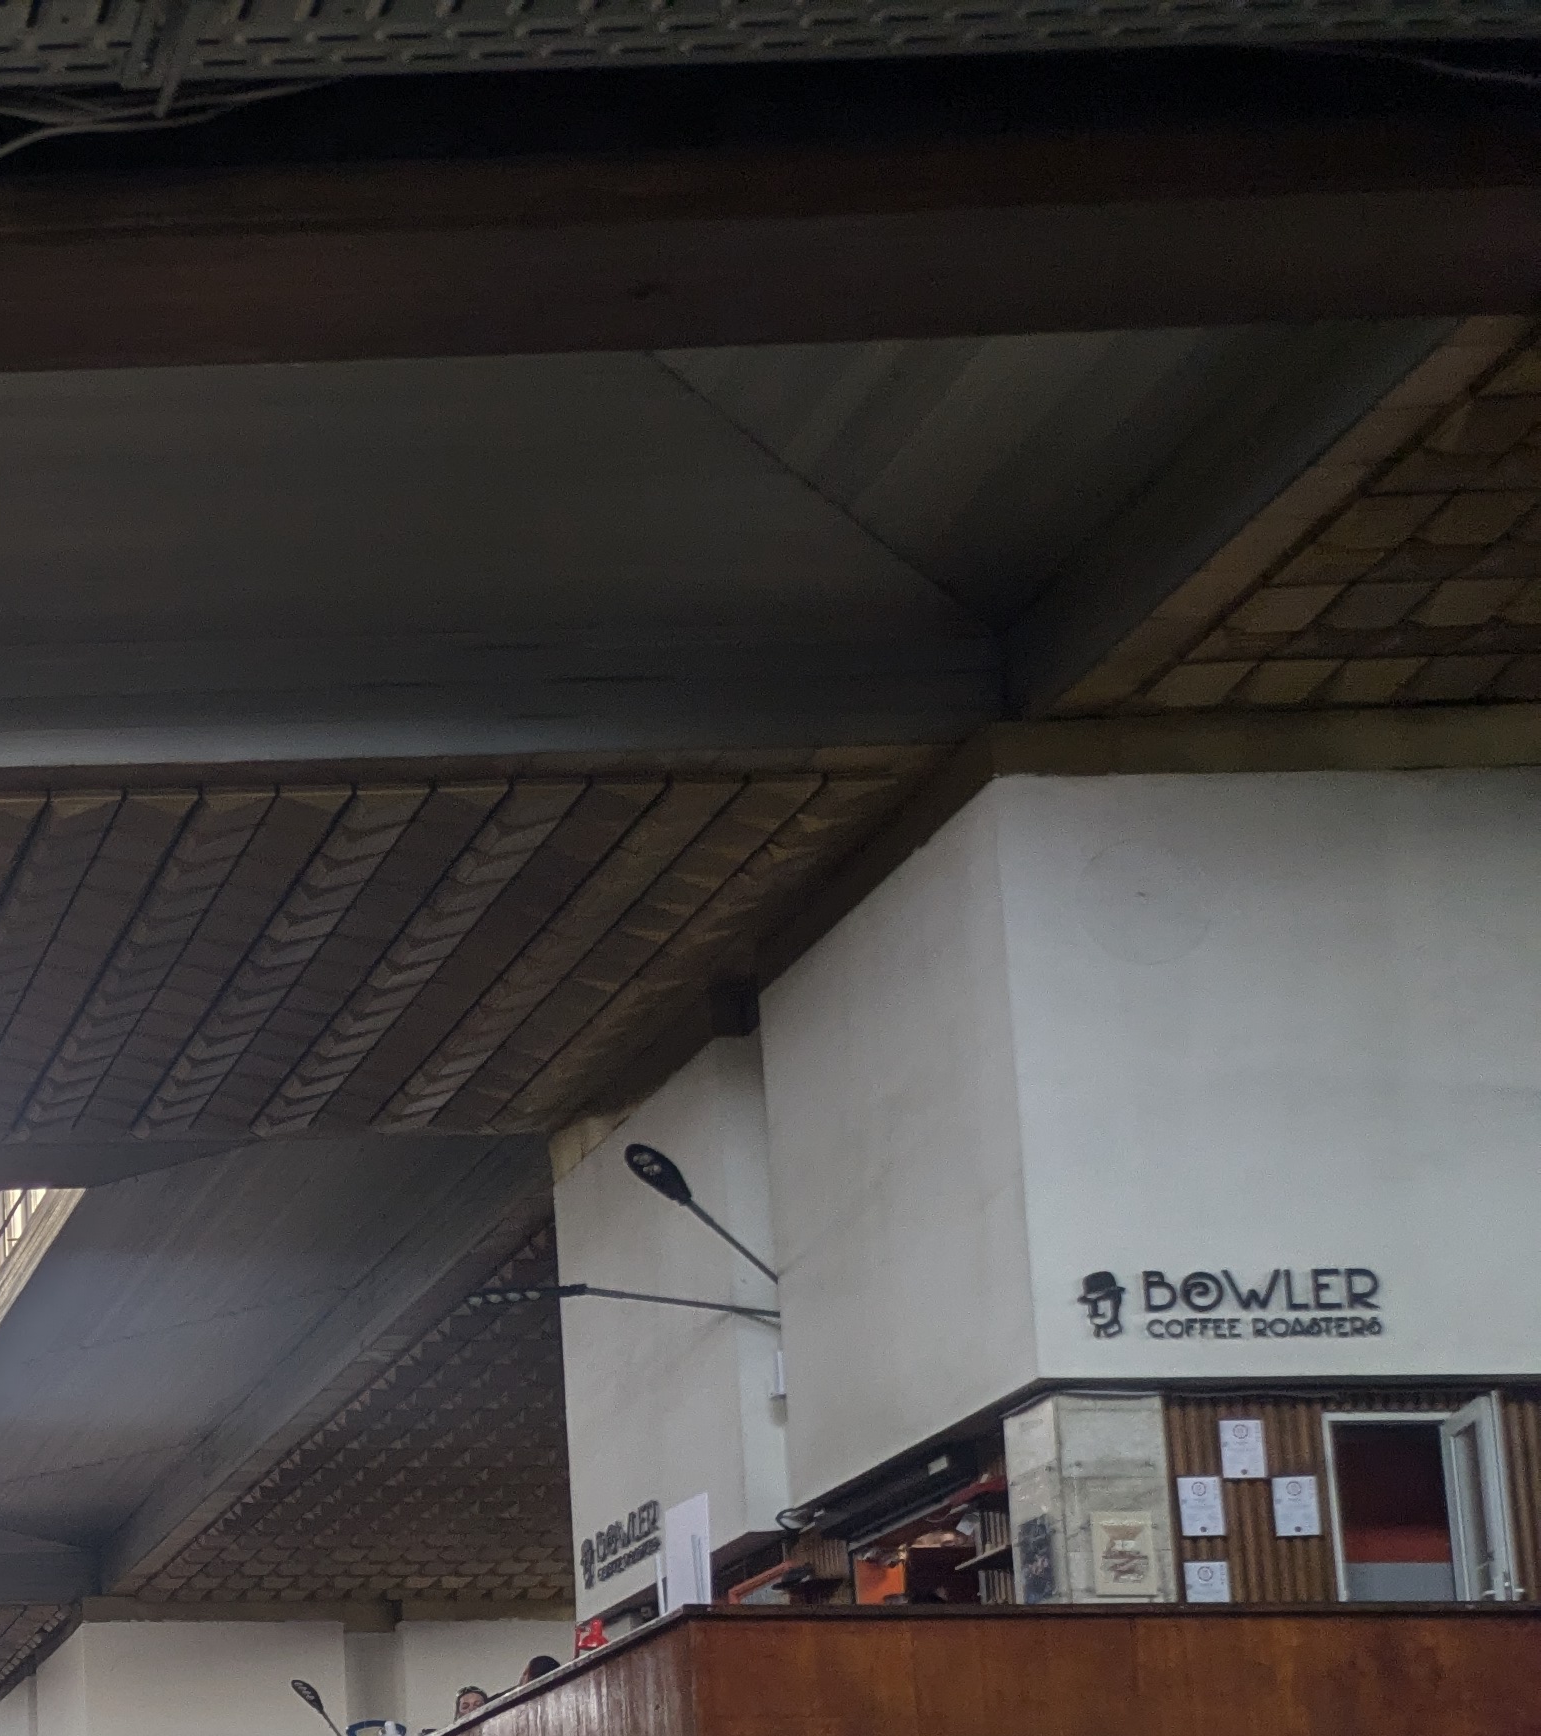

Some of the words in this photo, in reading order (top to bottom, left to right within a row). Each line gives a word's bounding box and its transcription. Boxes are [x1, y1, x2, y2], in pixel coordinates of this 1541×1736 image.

[1143, 1269, 1381, 1313] BOWLER
[1146, 1318, 1242, 1339] COFFEE
[1252, 1316, 1383, 1338] ROASTERS
